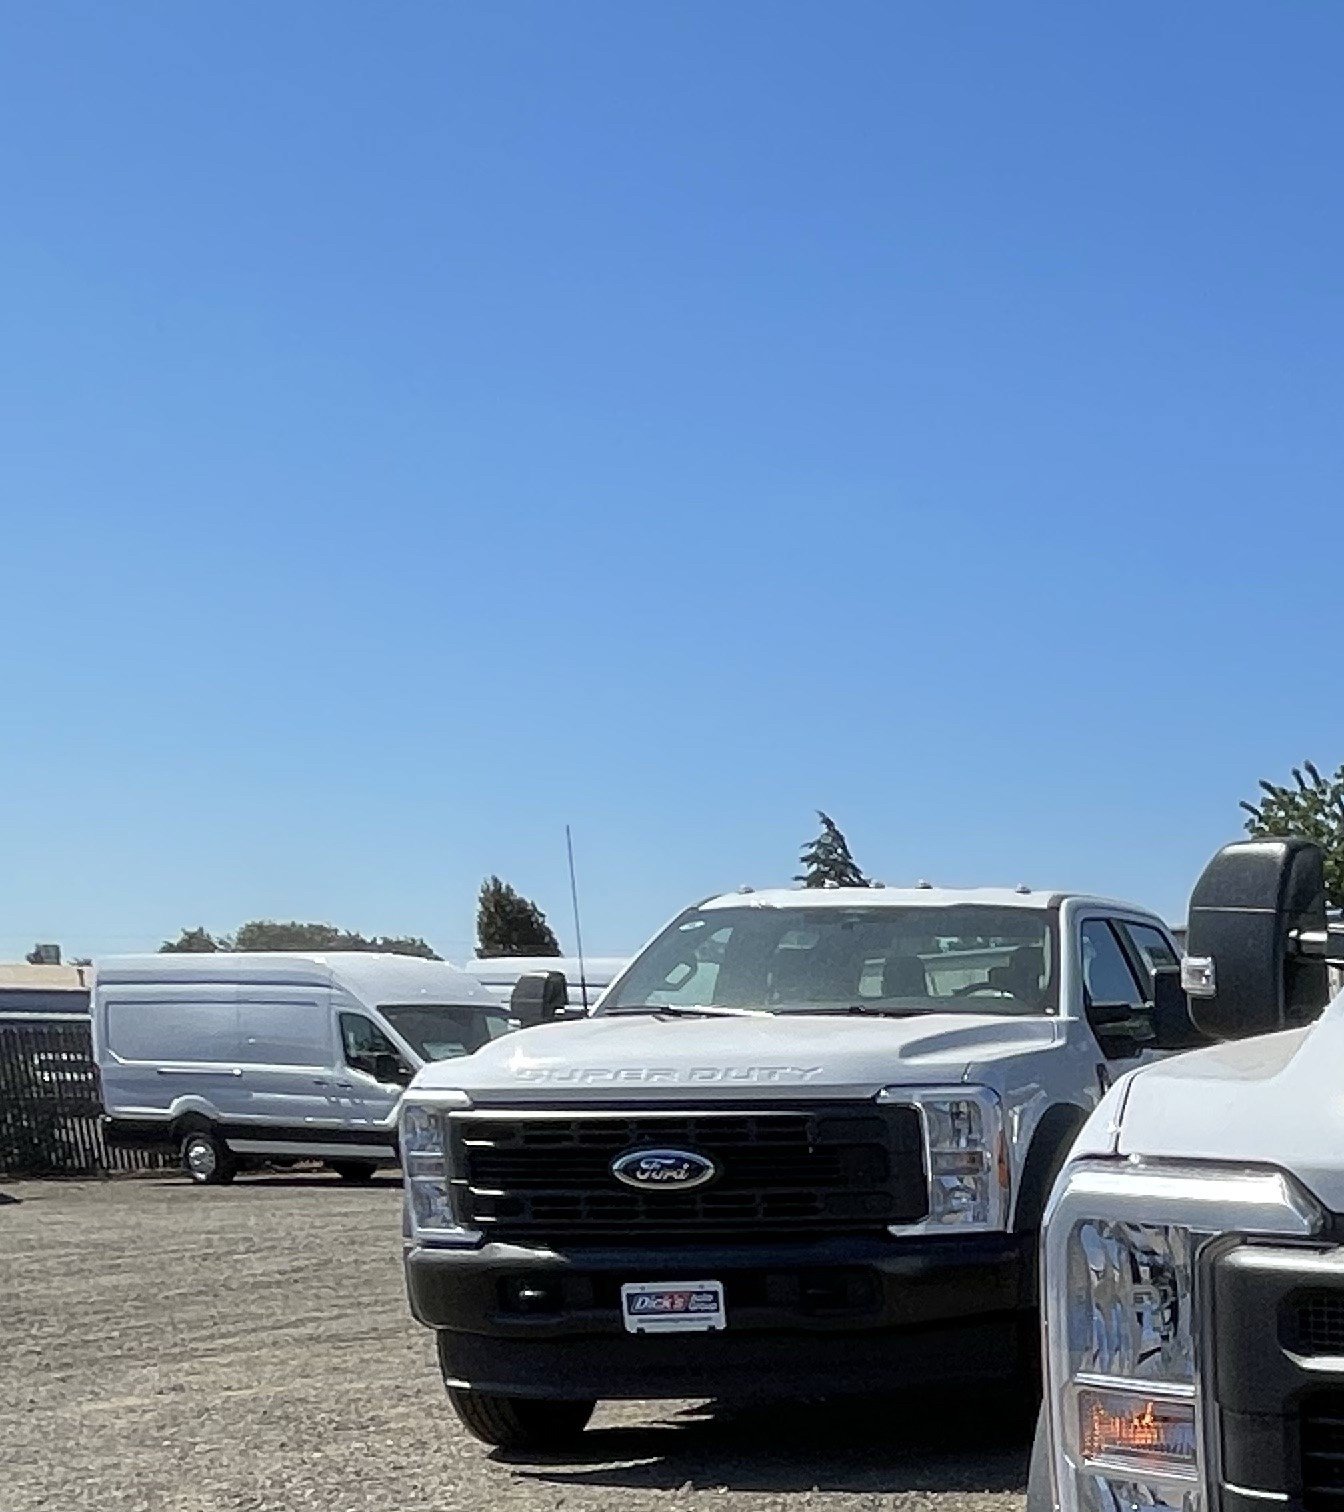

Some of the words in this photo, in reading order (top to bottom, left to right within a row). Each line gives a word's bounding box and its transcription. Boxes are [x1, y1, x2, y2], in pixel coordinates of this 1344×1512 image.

[514, 1067, 679, 1084] SUPER
[689, 1065, 824, 1082] DUTY
[636, 1158, 689, 1180] Ford
